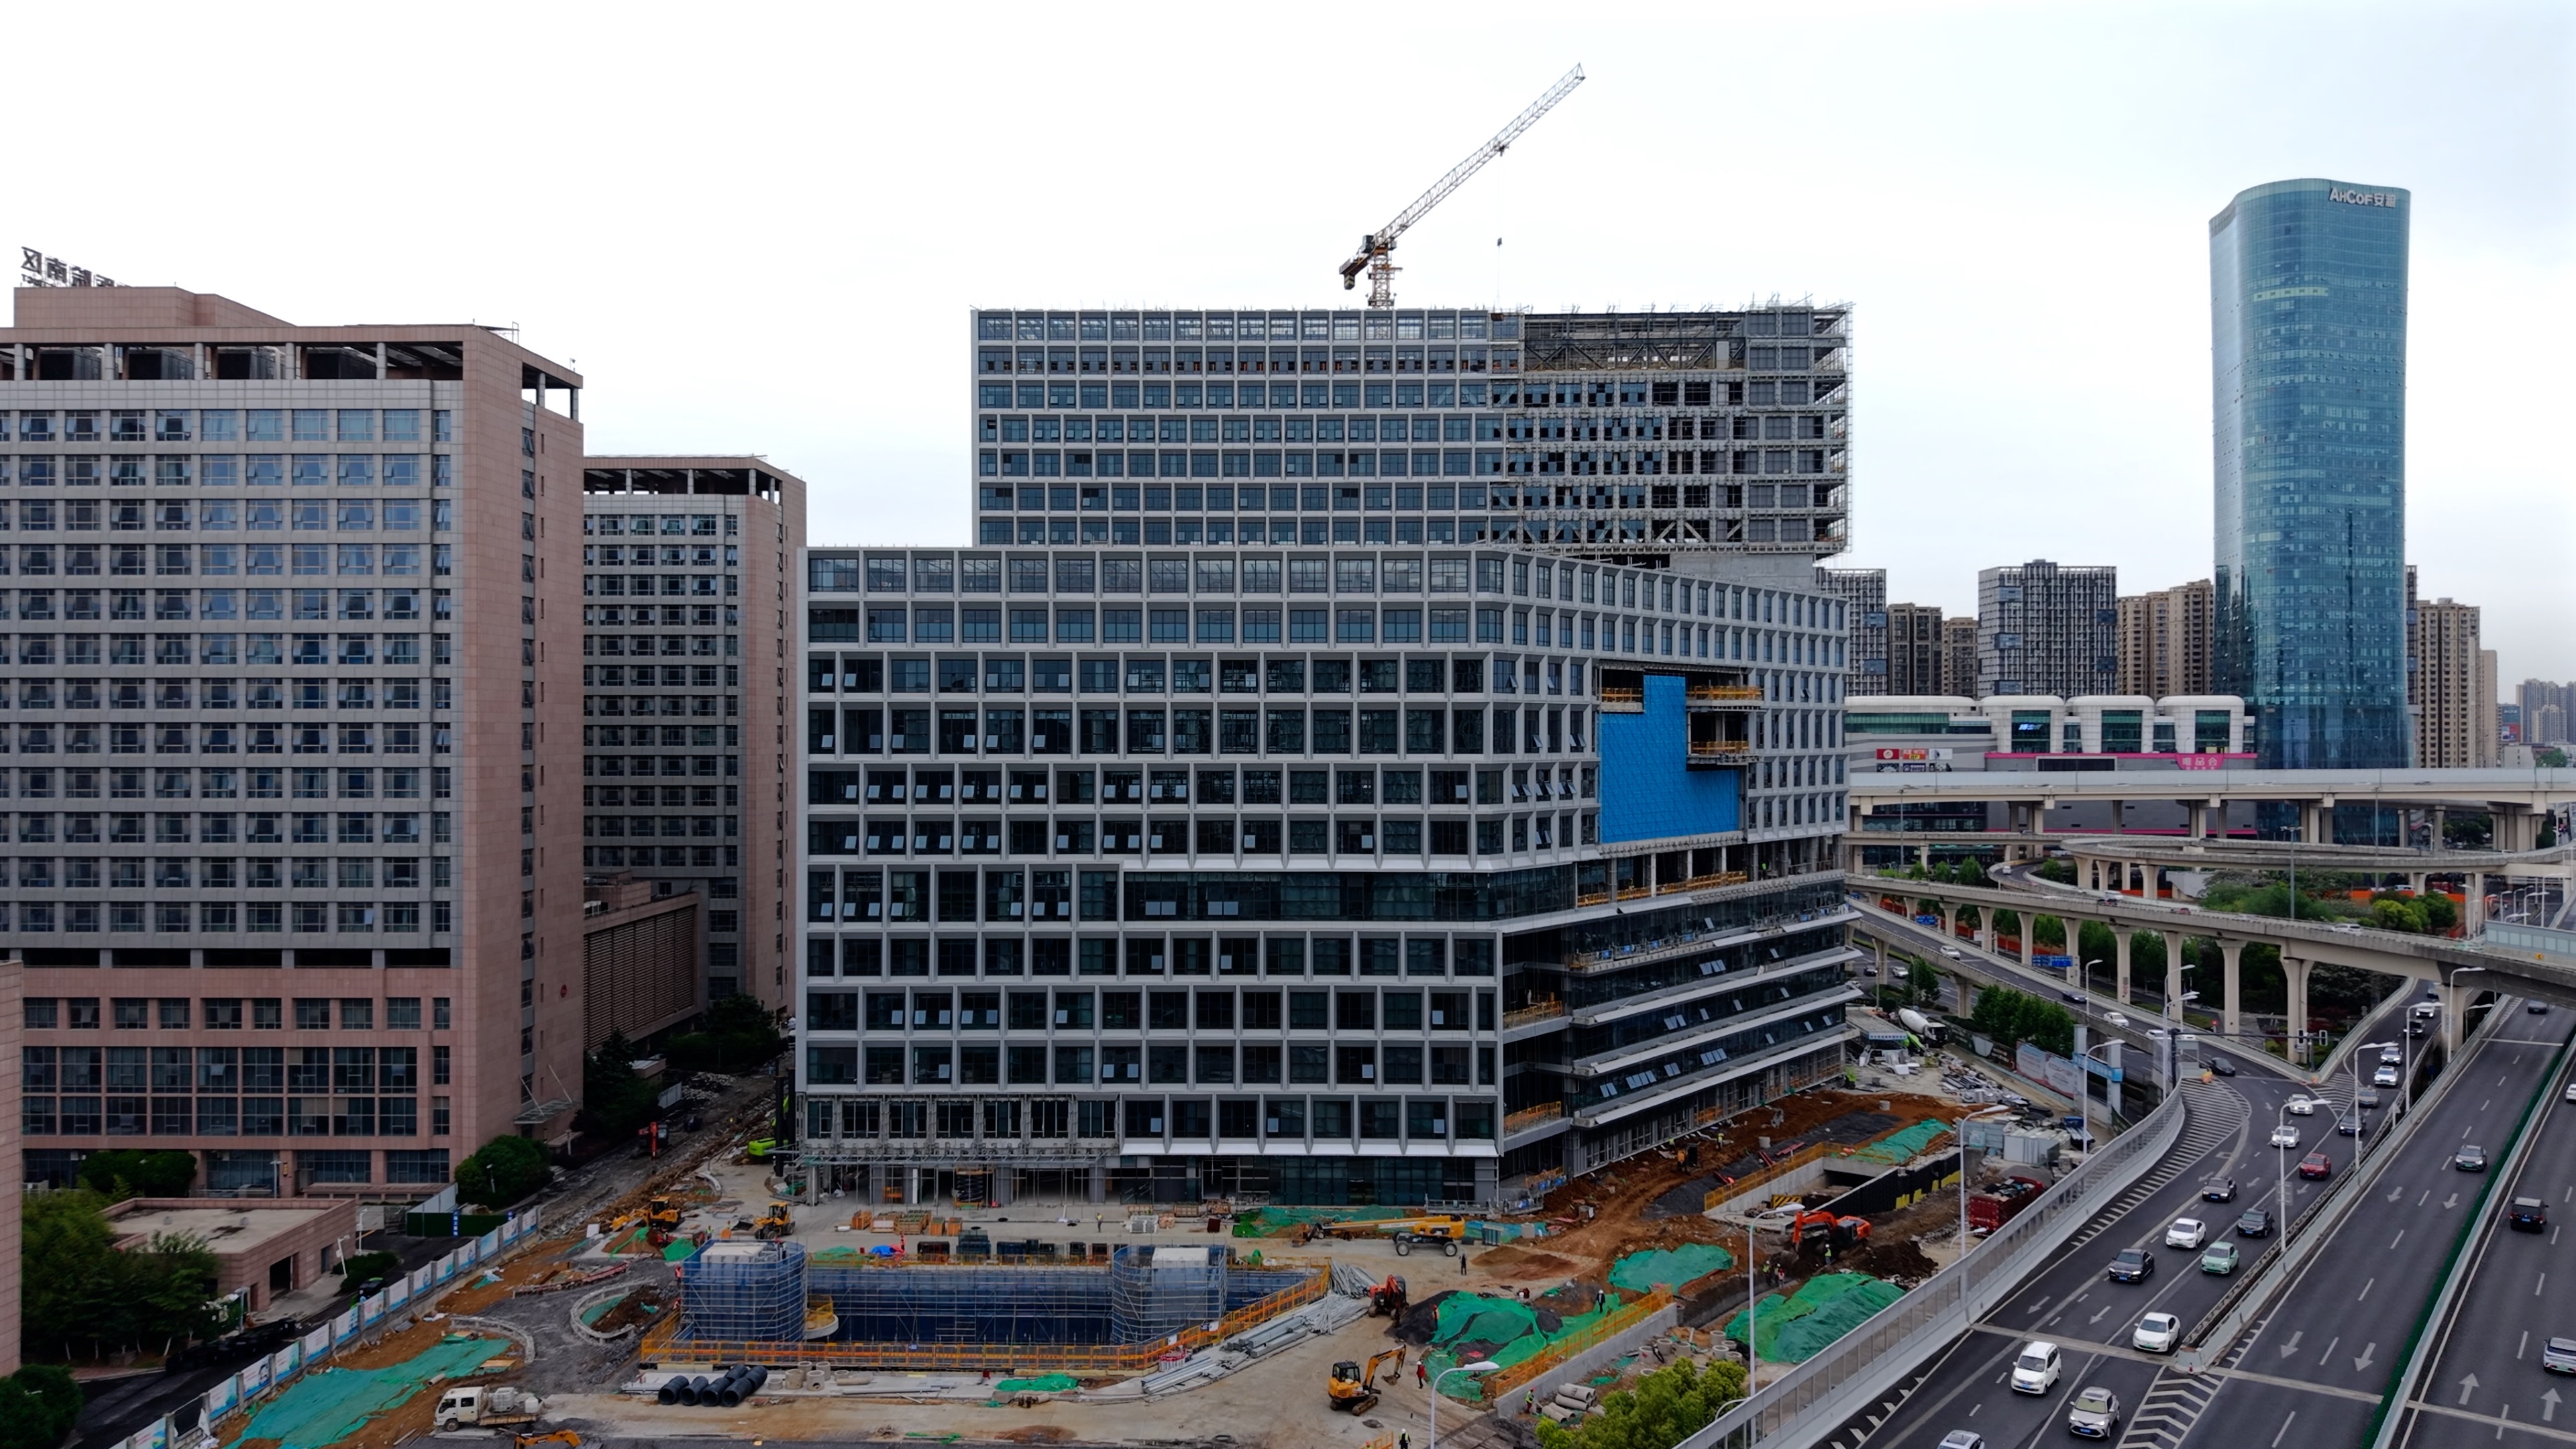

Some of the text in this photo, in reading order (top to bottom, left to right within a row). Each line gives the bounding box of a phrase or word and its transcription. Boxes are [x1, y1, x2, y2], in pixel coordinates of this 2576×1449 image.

[2329, 186, 2373, 205] AHCOF
[2182, 757, 2218, 766] 唯品会
